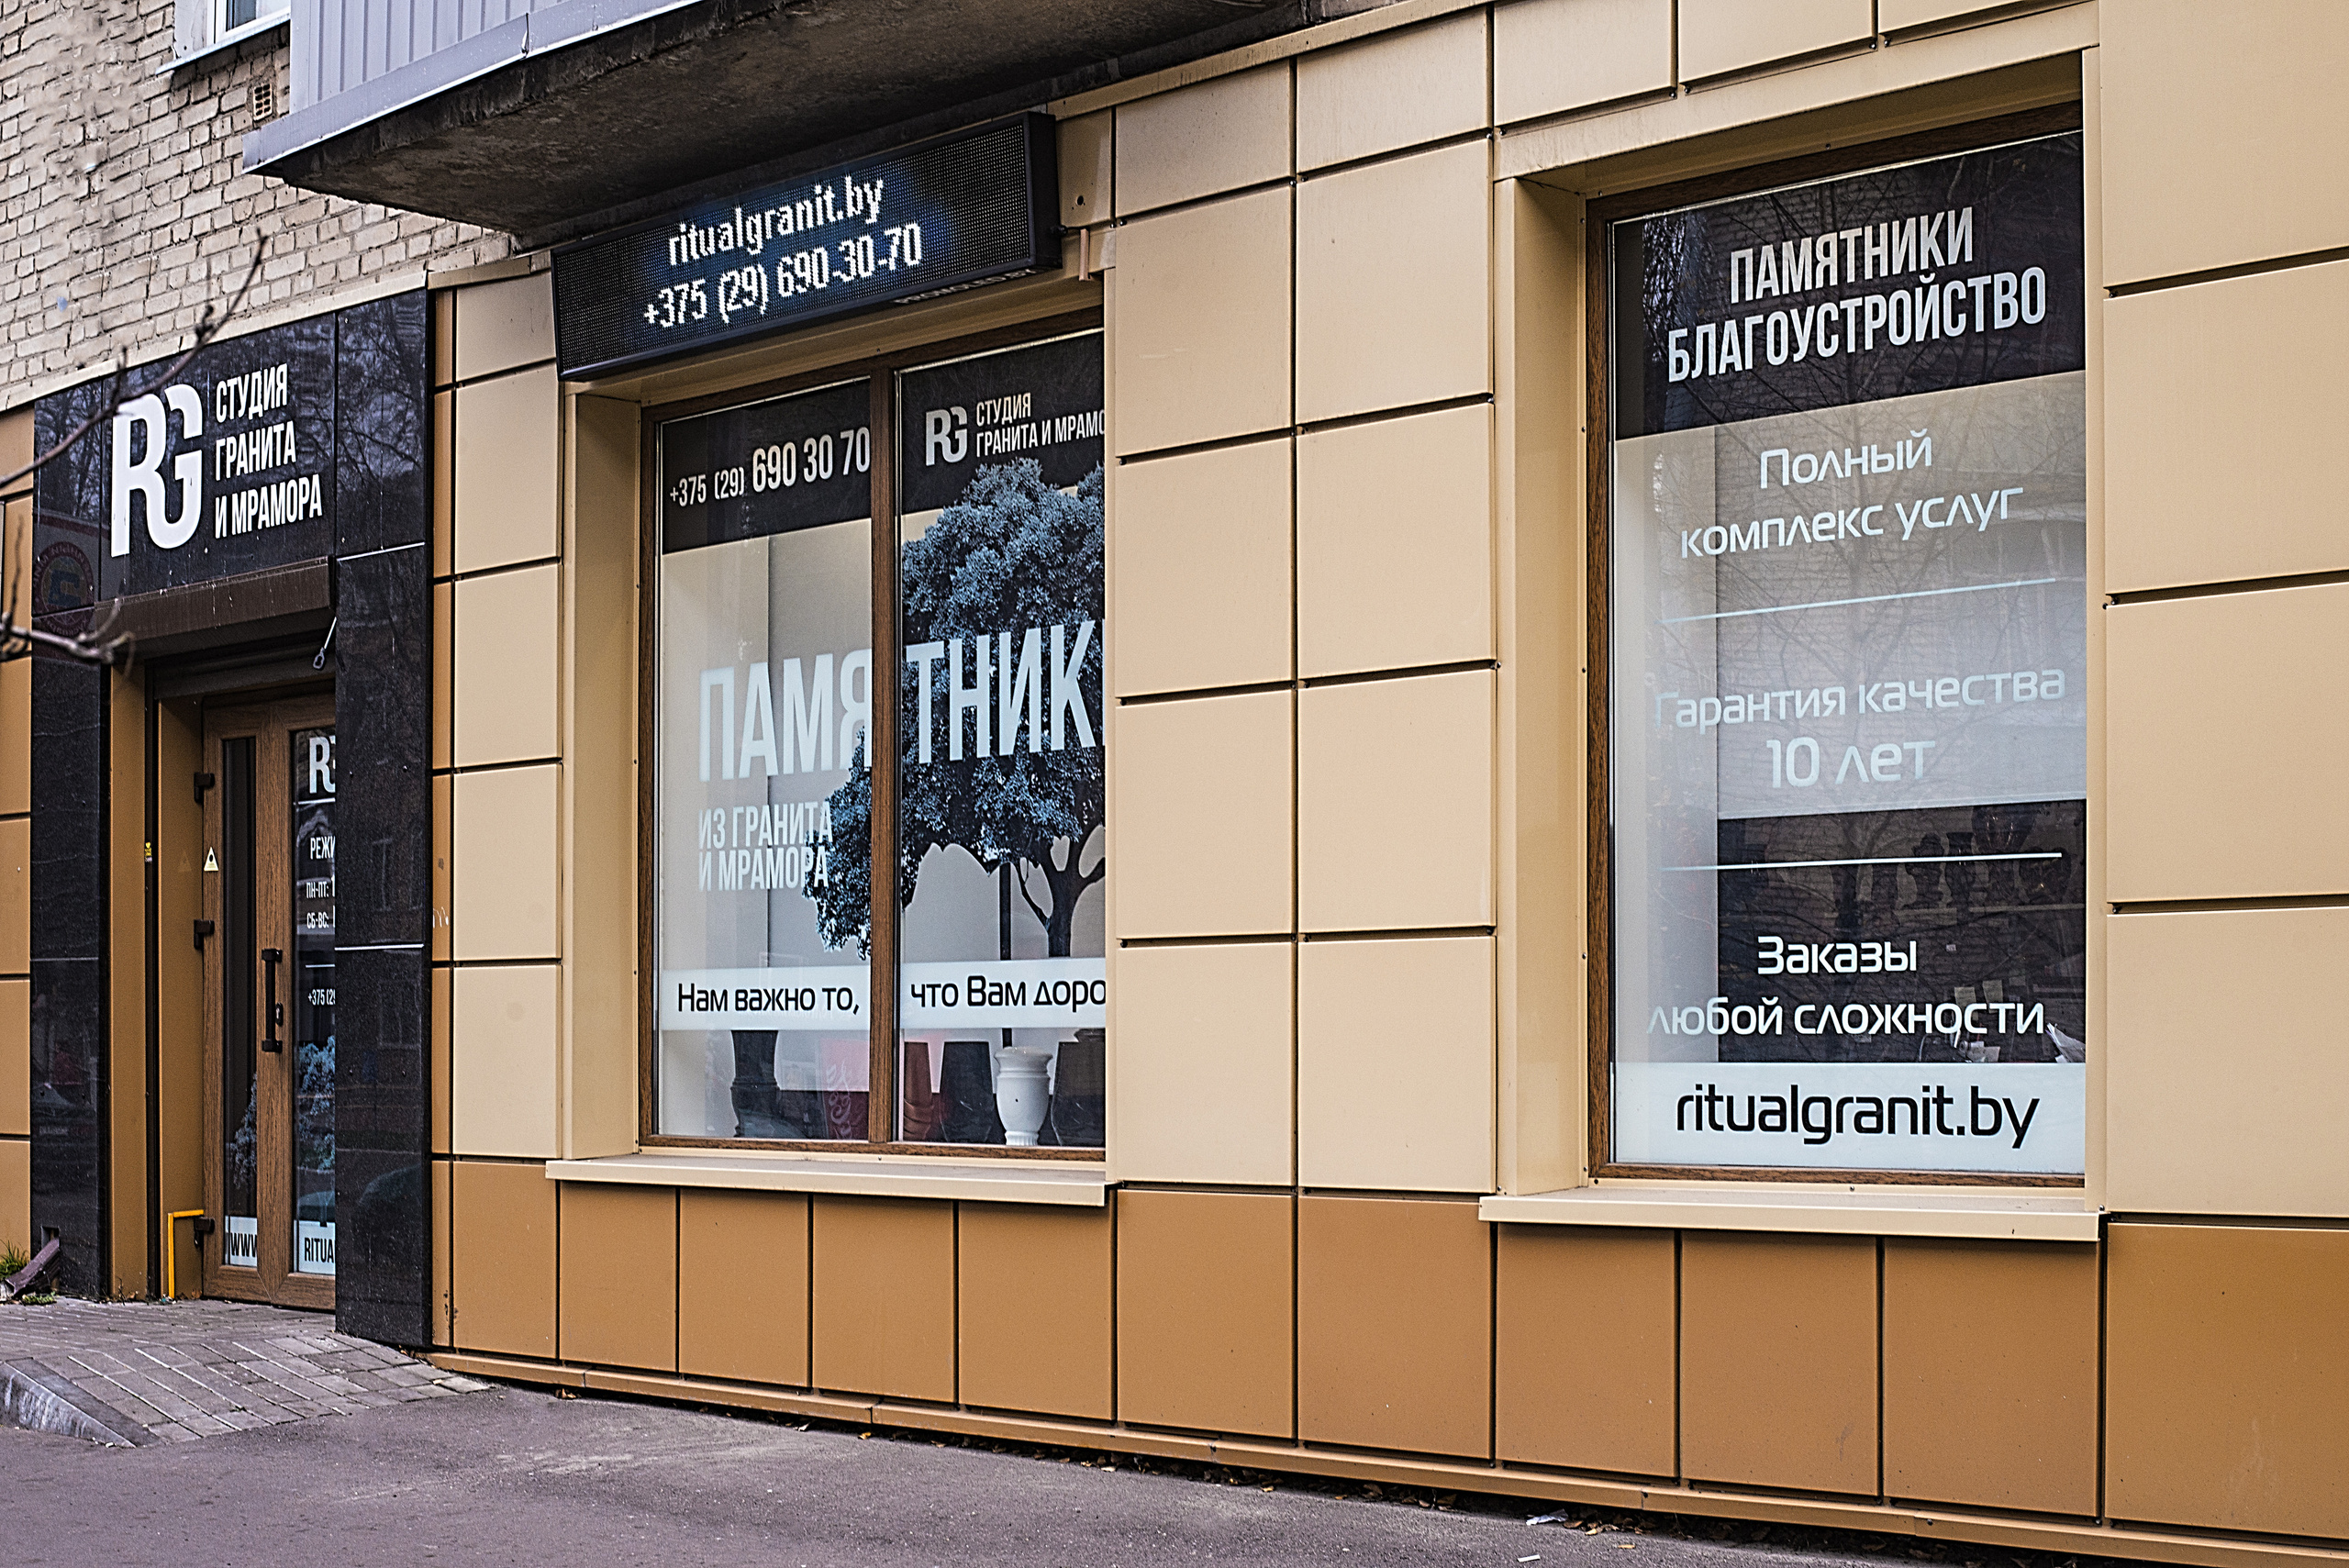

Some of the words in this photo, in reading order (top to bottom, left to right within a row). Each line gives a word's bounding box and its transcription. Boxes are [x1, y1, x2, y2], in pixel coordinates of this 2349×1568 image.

[669, 175, 883, 266] ritualgranit.by
[644, 279, 707, 328] +375
[718, 264, 768, 324] (29)
[778, 223, 922, 297] 690-30-70
[1730, 206, 1973, 304] ПАМЯТНИКИ
[1668, 266, 2046, 383] БЛАГОУСТРОЙСТВО
[216, 363, 288, 422] СТУДИЯ
[976, 393, 1031, 427] СТУДИЯ
[216, 421, 296, 481] ГРАНИТА
[926, 406, 967, 466] RG
[976, 421, 1038, 457] ГРАНИТА
[1041, 419, 1051, 445] И
[1760, 428, 1932, 489] Полный
[111, 384, 203, 557] RG
[670, 474, 707, 506] +375
[714, 467, 745, 499] (29)
[752, 441, 796, 493] 690
[803, 434, 833, 483] 30
[840, 427, 870, 475] 70
[215, 496, 227, 539] И
[231, 474, 322, 536] МРАМОРА
[1681, 505, 1884, 559] комплекс
[1894, 487, 2023, 540] услуг
[699, 618, 1105, 782] ПАМЯТНИК
[1653, 685, 1846, 733] Гарантия
[1858, 668, 2065, 715] качества
[1766, 737, 1820, 789] 10
[1835, 740, 1936, 784] лет
[698, 807, 726, 850] ИЗ
[732, 801, 833, 848] ГРАНИТА
[698, 851, 712, 892] И
[718, 846, 829, 891] МРАМОРА
[1757, 936, 1917, 974] Заказы
[307, 989, 325, 1006] +375
[678, 983, 728, 1012] Нам
[735, 988, 816, 1011] важно
[822, 987, 859, 1015] то,
[911, 983, 958, 1007] что
[967, 975, 1026, 1006] Вам
[1647, 996, 1783, 1036] любой
[1794, 1002, 2044, 1035] сложности
[1675, 1084, 2041, 1149] ritualgranit.by
